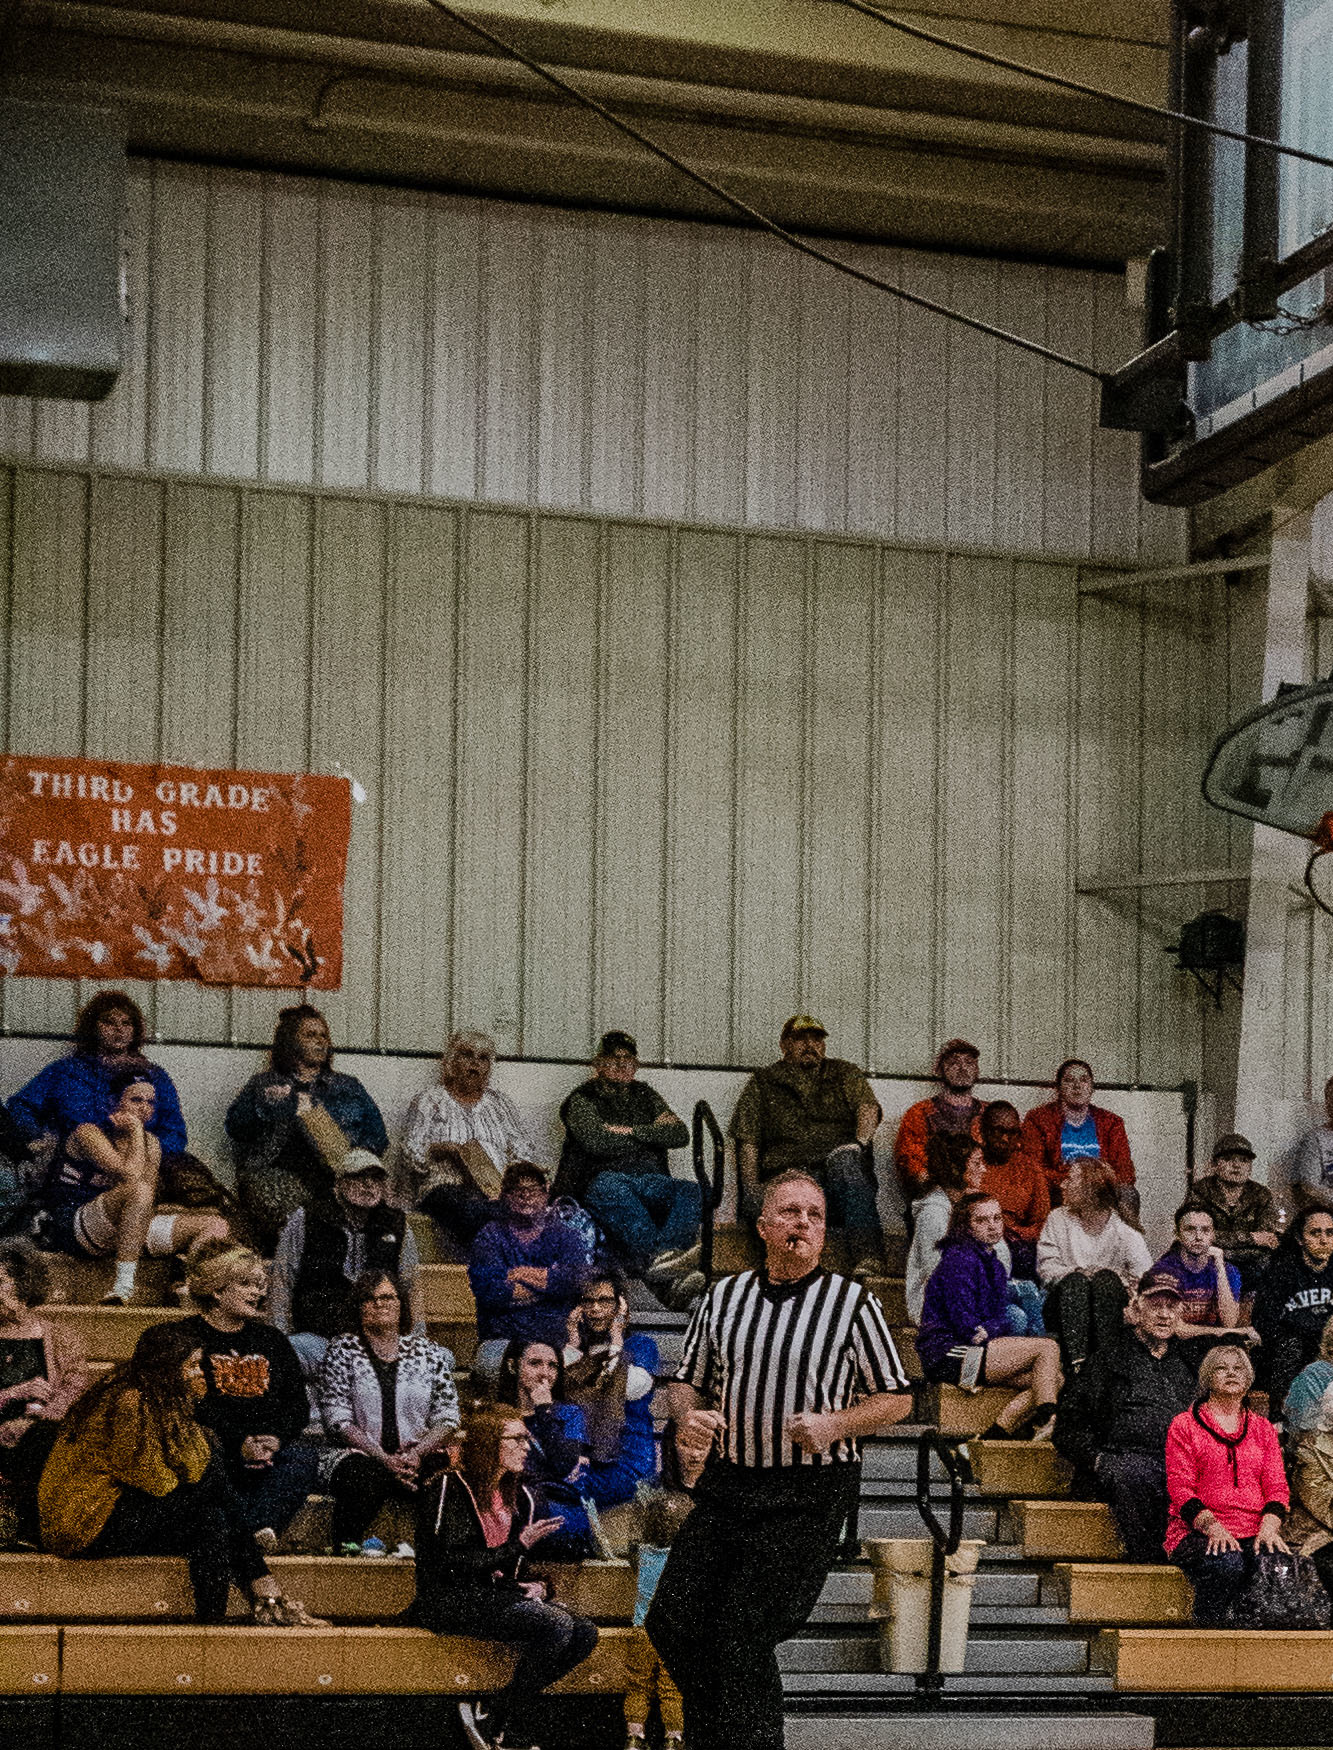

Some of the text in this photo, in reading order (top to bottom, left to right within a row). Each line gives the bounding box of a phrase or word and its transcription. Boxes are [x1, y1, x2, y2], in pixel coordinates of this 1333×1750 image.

[28, 770, 272, 813] THIRD GRADE
[111, 808, 178, 836] HAS
[32, 839, 265, 877] EAGLE PRIDE
